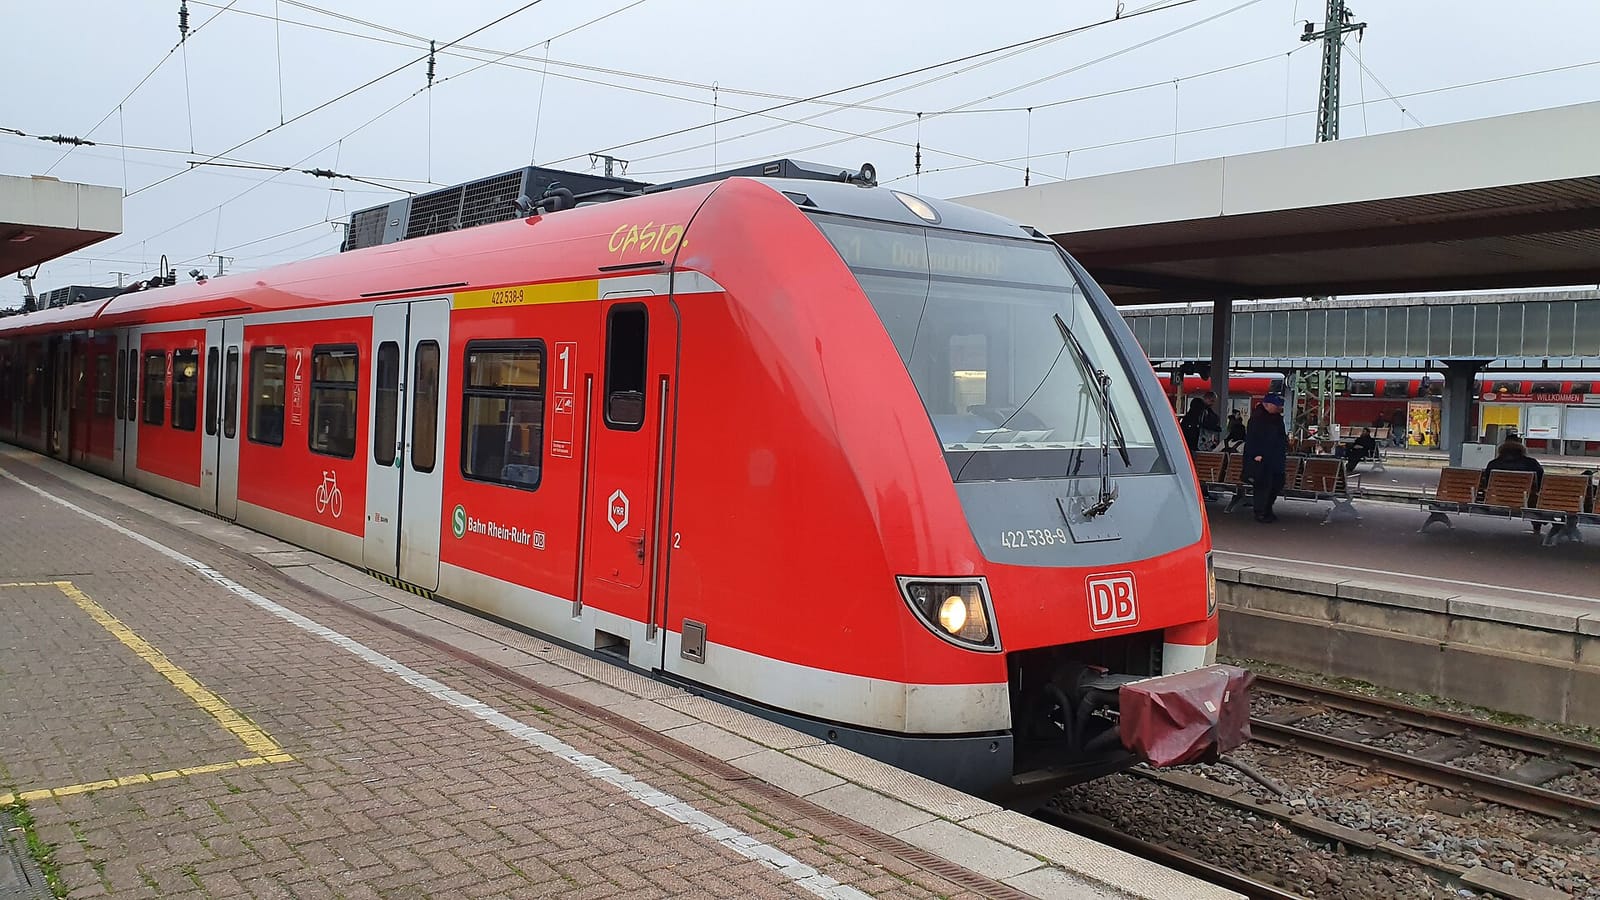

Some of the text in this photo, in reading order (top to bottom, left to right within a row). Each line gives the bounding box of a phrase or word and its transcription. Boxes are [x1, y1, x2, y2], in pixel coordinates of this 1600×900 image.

[491, 289, 524, 304] 422 538-9
[167, 353, 172, 375] 2
[294, 351, 302, 380] 2
[560, 346, 569, 390] 1
[1536, 393, 1580, 402] WILLKOMMEN
[612, 505, 625, 516] VRR
[454, 508, 545, 547] S Bahn Rhein-Ruhr DB
[674, 532, 681, 548] 2
[1001, 528, 1067, 549] 422 538-9
[1092, 580, 1134, 622] DB
